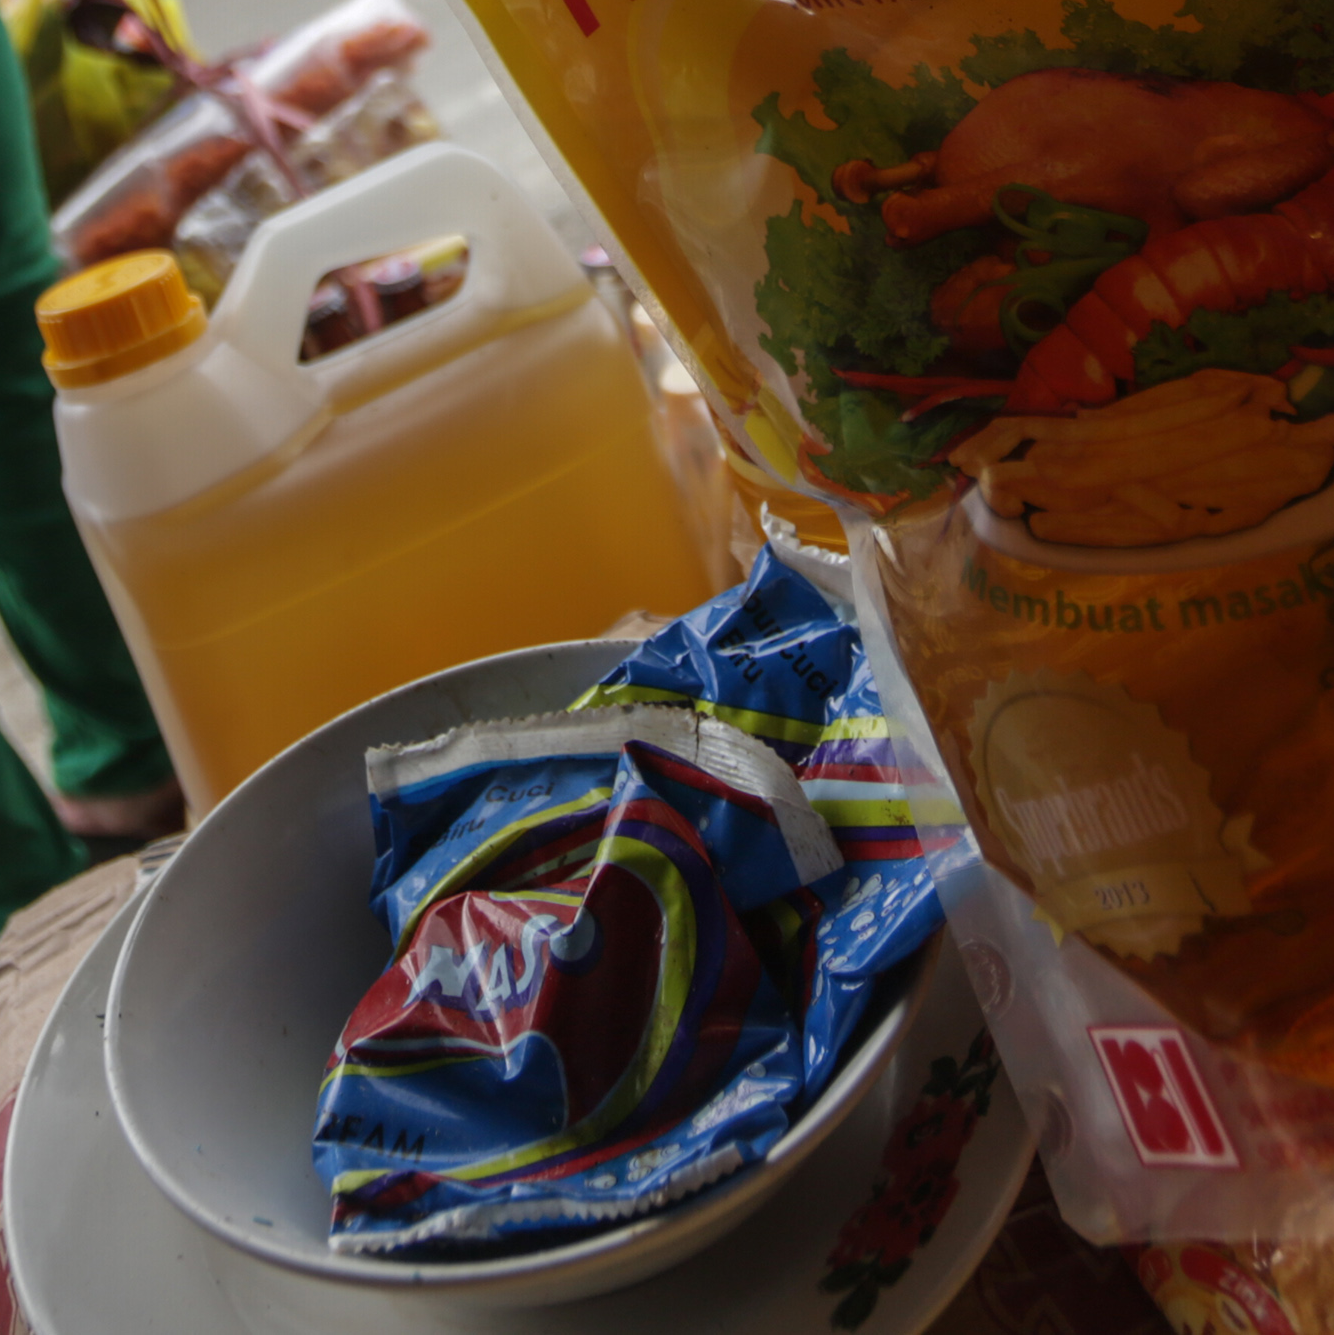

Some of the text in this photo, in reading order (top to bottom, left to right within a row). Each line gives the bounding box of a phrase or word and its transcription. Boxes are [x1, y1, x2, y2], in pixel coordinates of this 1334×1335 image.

[964, 557, 1167, 632] Membuat
[485, 781, 555, 804] Cuci
[993, 752, 1190, 877] Superbrands
[1094, 880, 1151, 911] 2013
